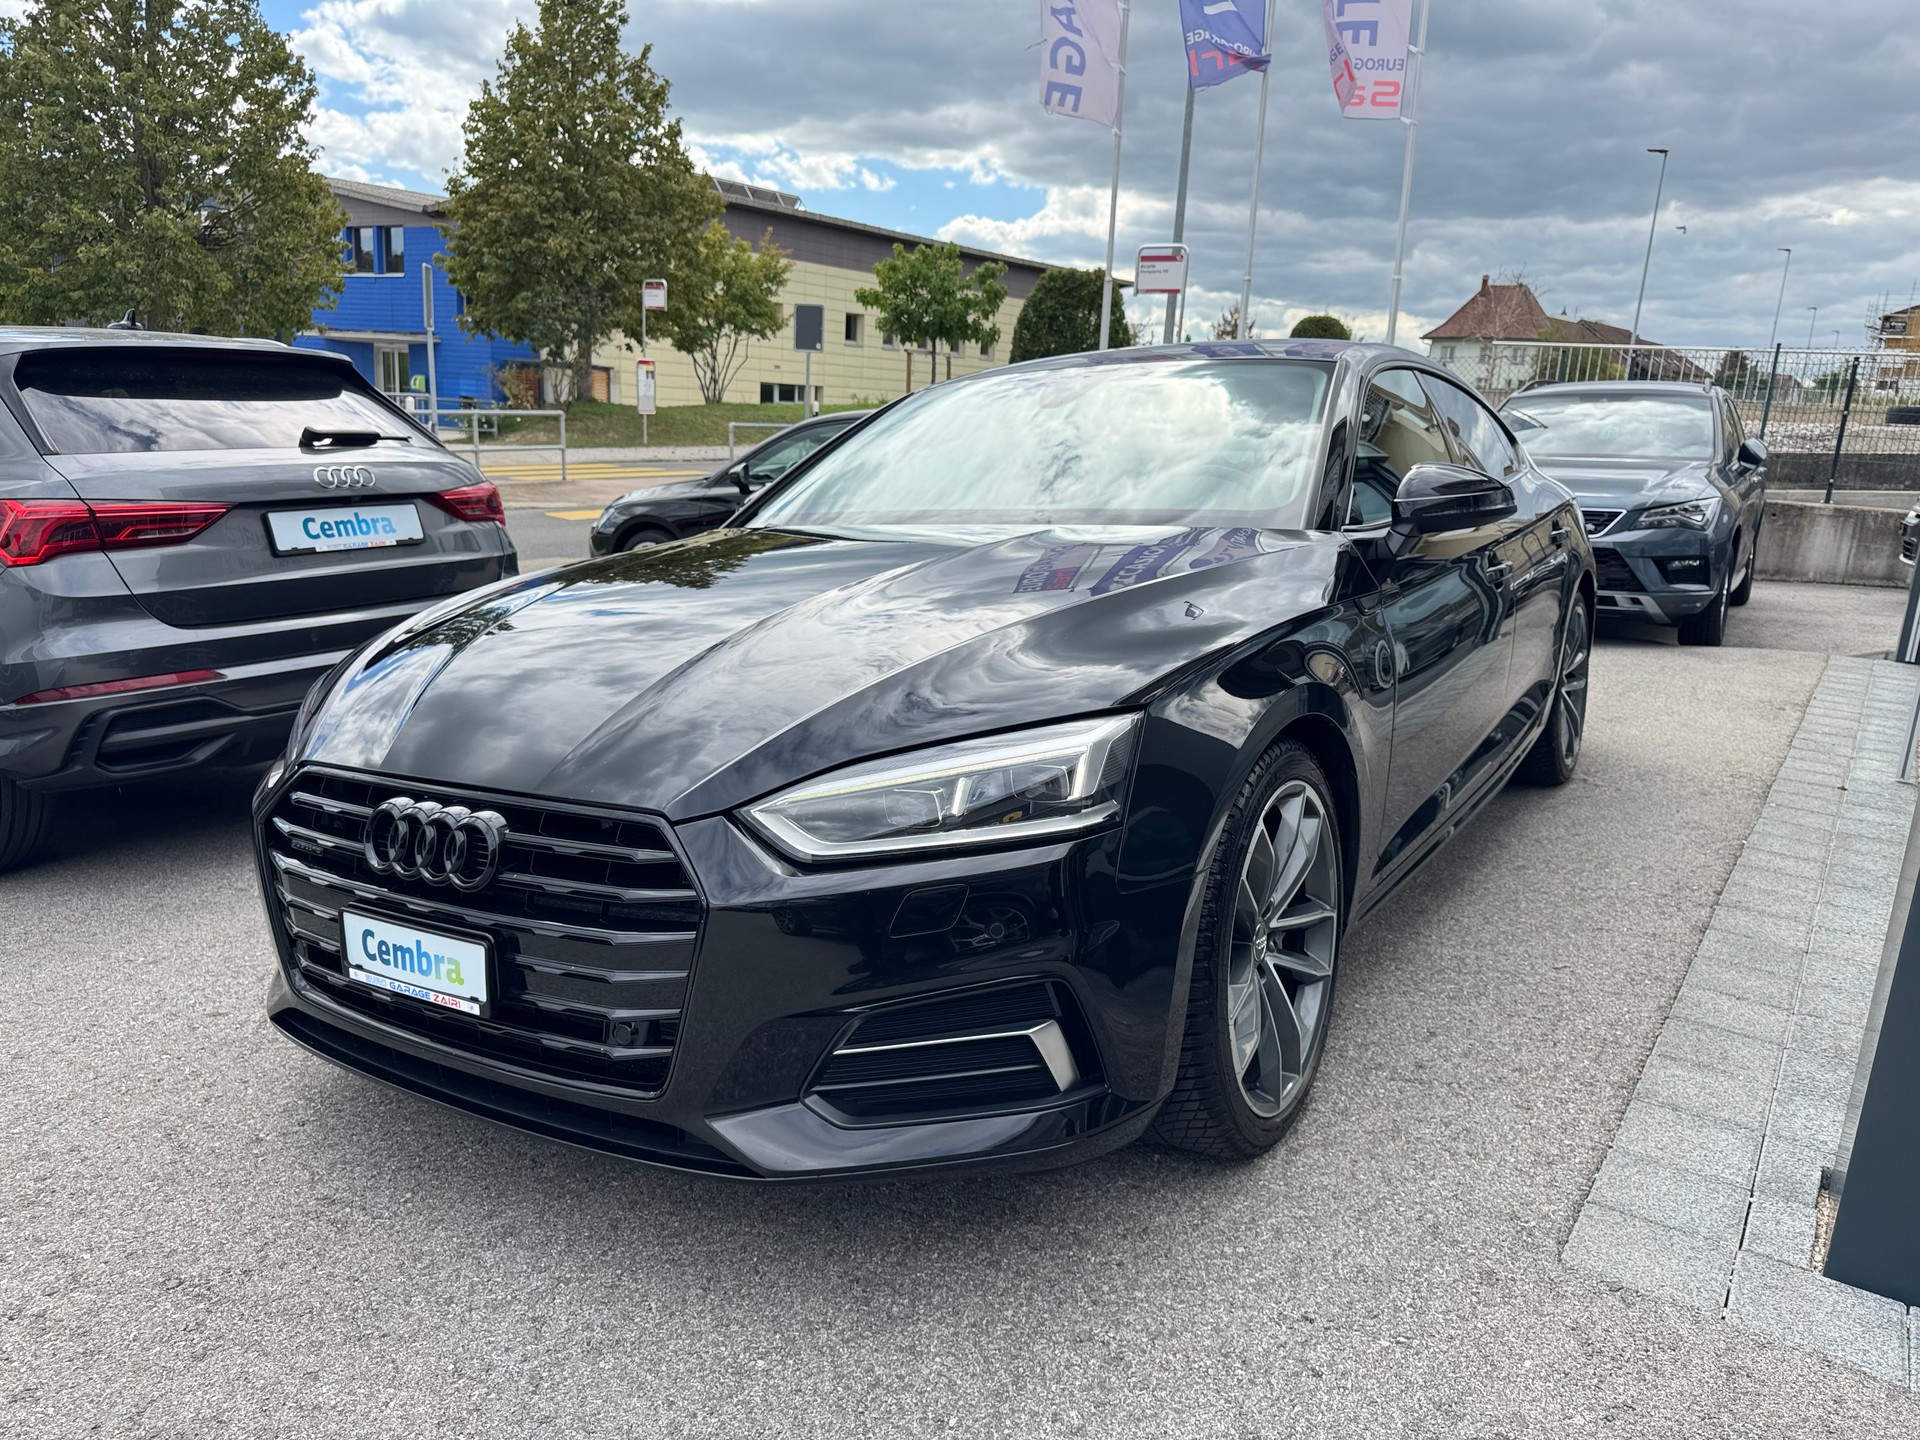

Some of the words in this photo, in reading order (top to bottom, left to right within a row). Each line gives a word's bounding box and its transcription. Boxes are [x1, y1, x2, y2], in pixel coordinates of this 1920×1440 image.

[303, 512, 397, 540] Cembra
[361, 928, 465, 986] Cembra
[389, 981, 432, 1001] GARAGE
[433, 993, 461, 1009] ZAIRI
